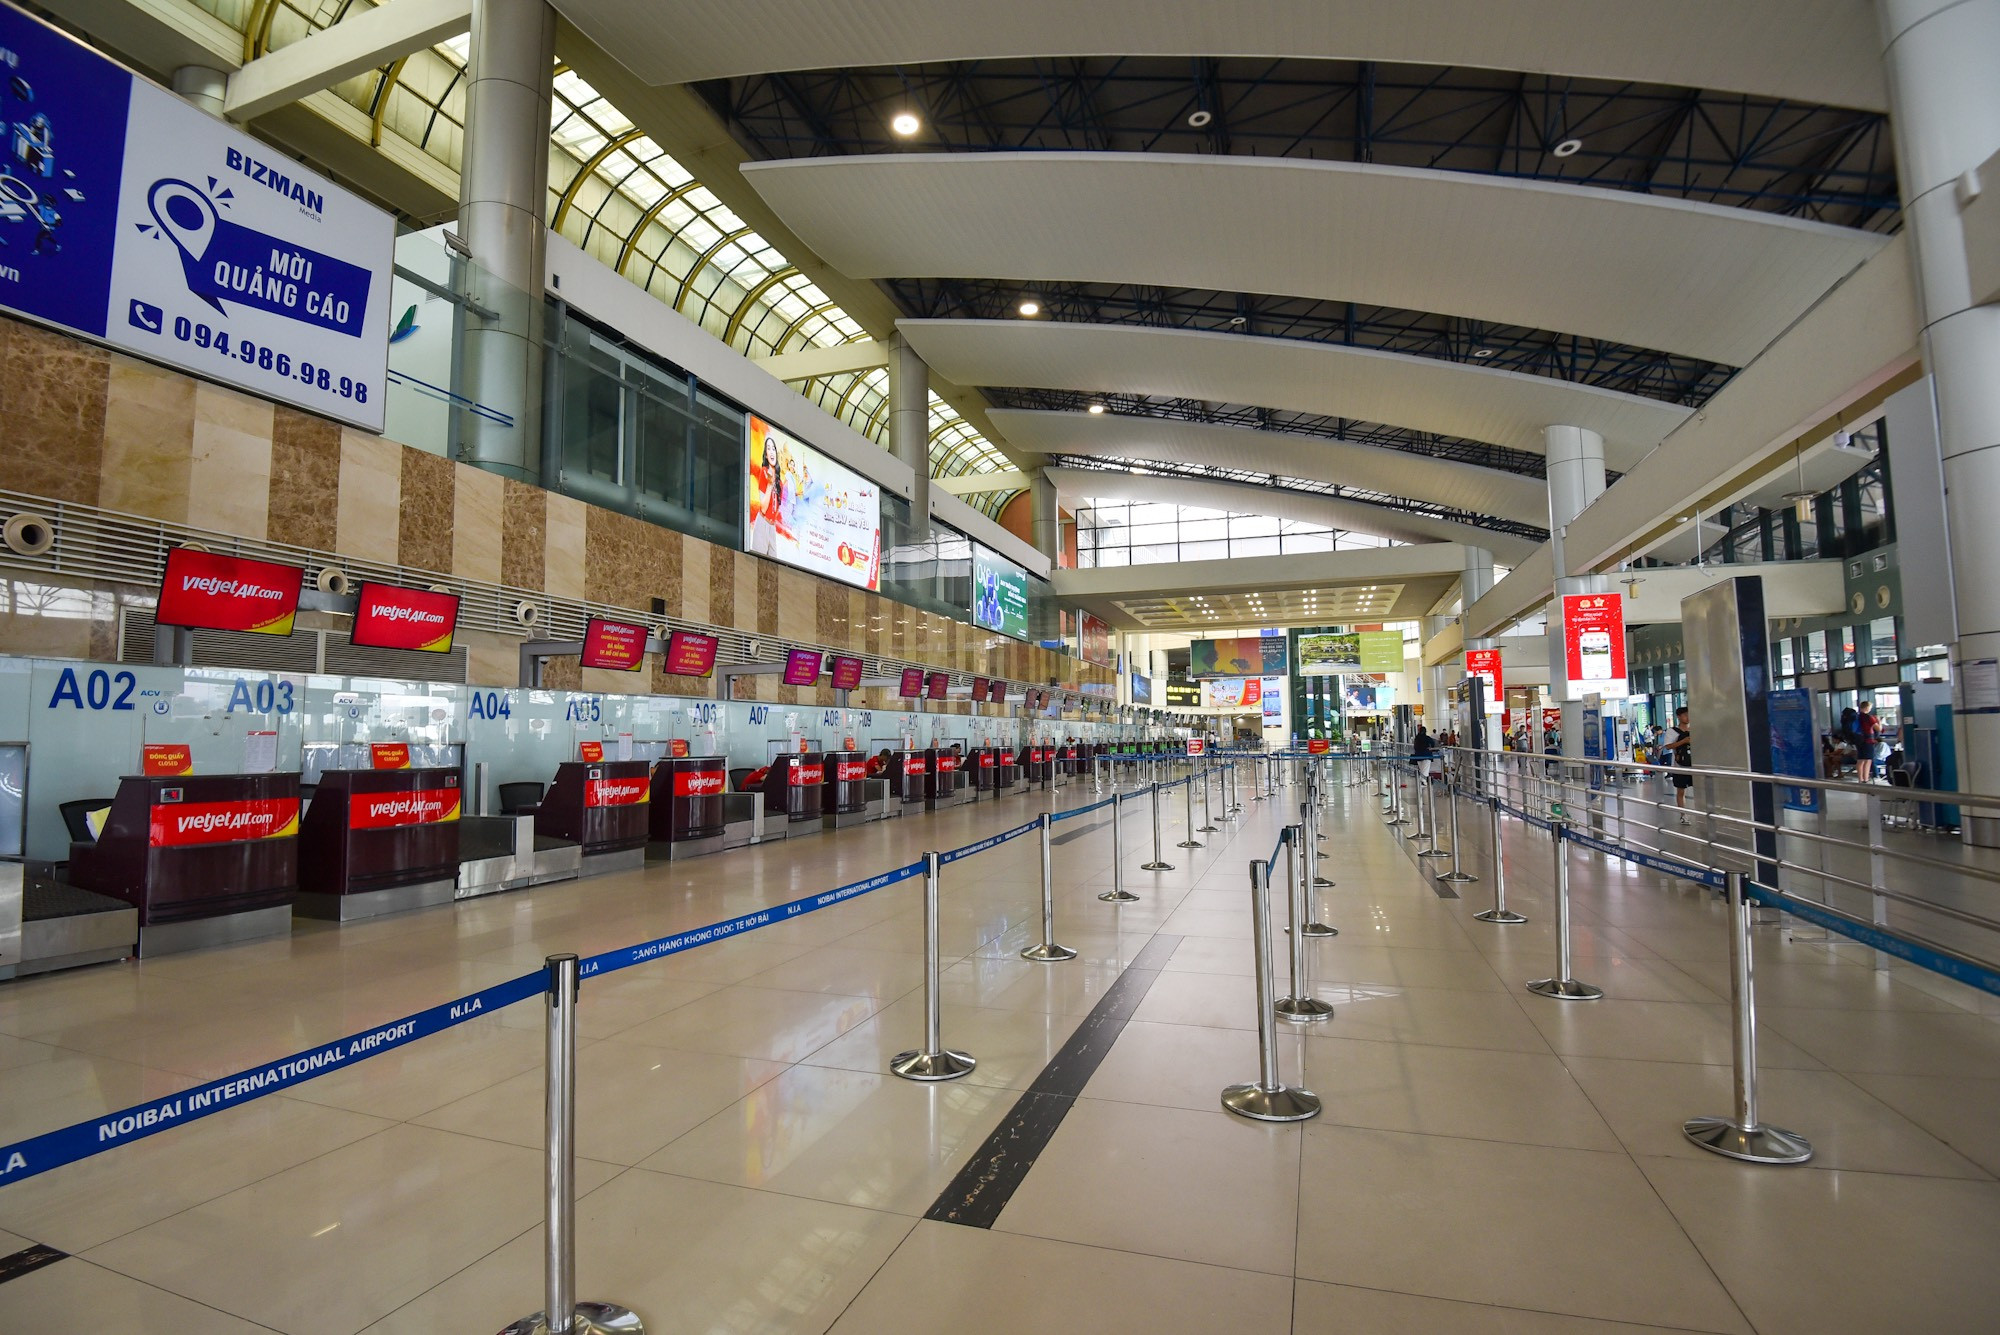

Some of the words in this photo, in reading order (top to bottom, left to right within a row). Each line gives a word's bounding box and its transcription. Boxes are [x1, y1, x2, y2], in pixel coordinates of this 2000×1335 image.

[226, 146, 323, 214] BIZMAN
[299, 207, 321, 223] Media
[269, 248, 313, 284] MỜI
[214, 260, 298, 308] QUẢNG
[305, 291, 350, 324] CÁO
[174, 316, 368, 404] 094.986.98.98
[48, 667, 136, 711] A02
[227, 677, 294, 715] A03
[468, 691, 511, 720] A04
[566, 696, 600, 721] A05
[693, 703, 717, 724] A06
[748, 706, 769, 725] A07
[858, 712, 872, 727] A09
[900, 868, 910, 877] N.I.A
[1658, 861, 1686, 875] INTERNATIONAL
[1686, 869, 1704, 880] AIRPORT
[817, 892, 835, 905] NOIBAI
[836, 882, 870, 900] INTERNATIONAL
[869, 875, 889, 889] AIRPORT
[787, 904, 801, 915] N.I.A
[450, 998, 482, 1020] N.I.A
[99, 1100, 182, 1142] NOIBAI
[188, 1047, 346, 1112] INTERNATIONAL
[349, 1020, 416, 1056] AIRPORT
